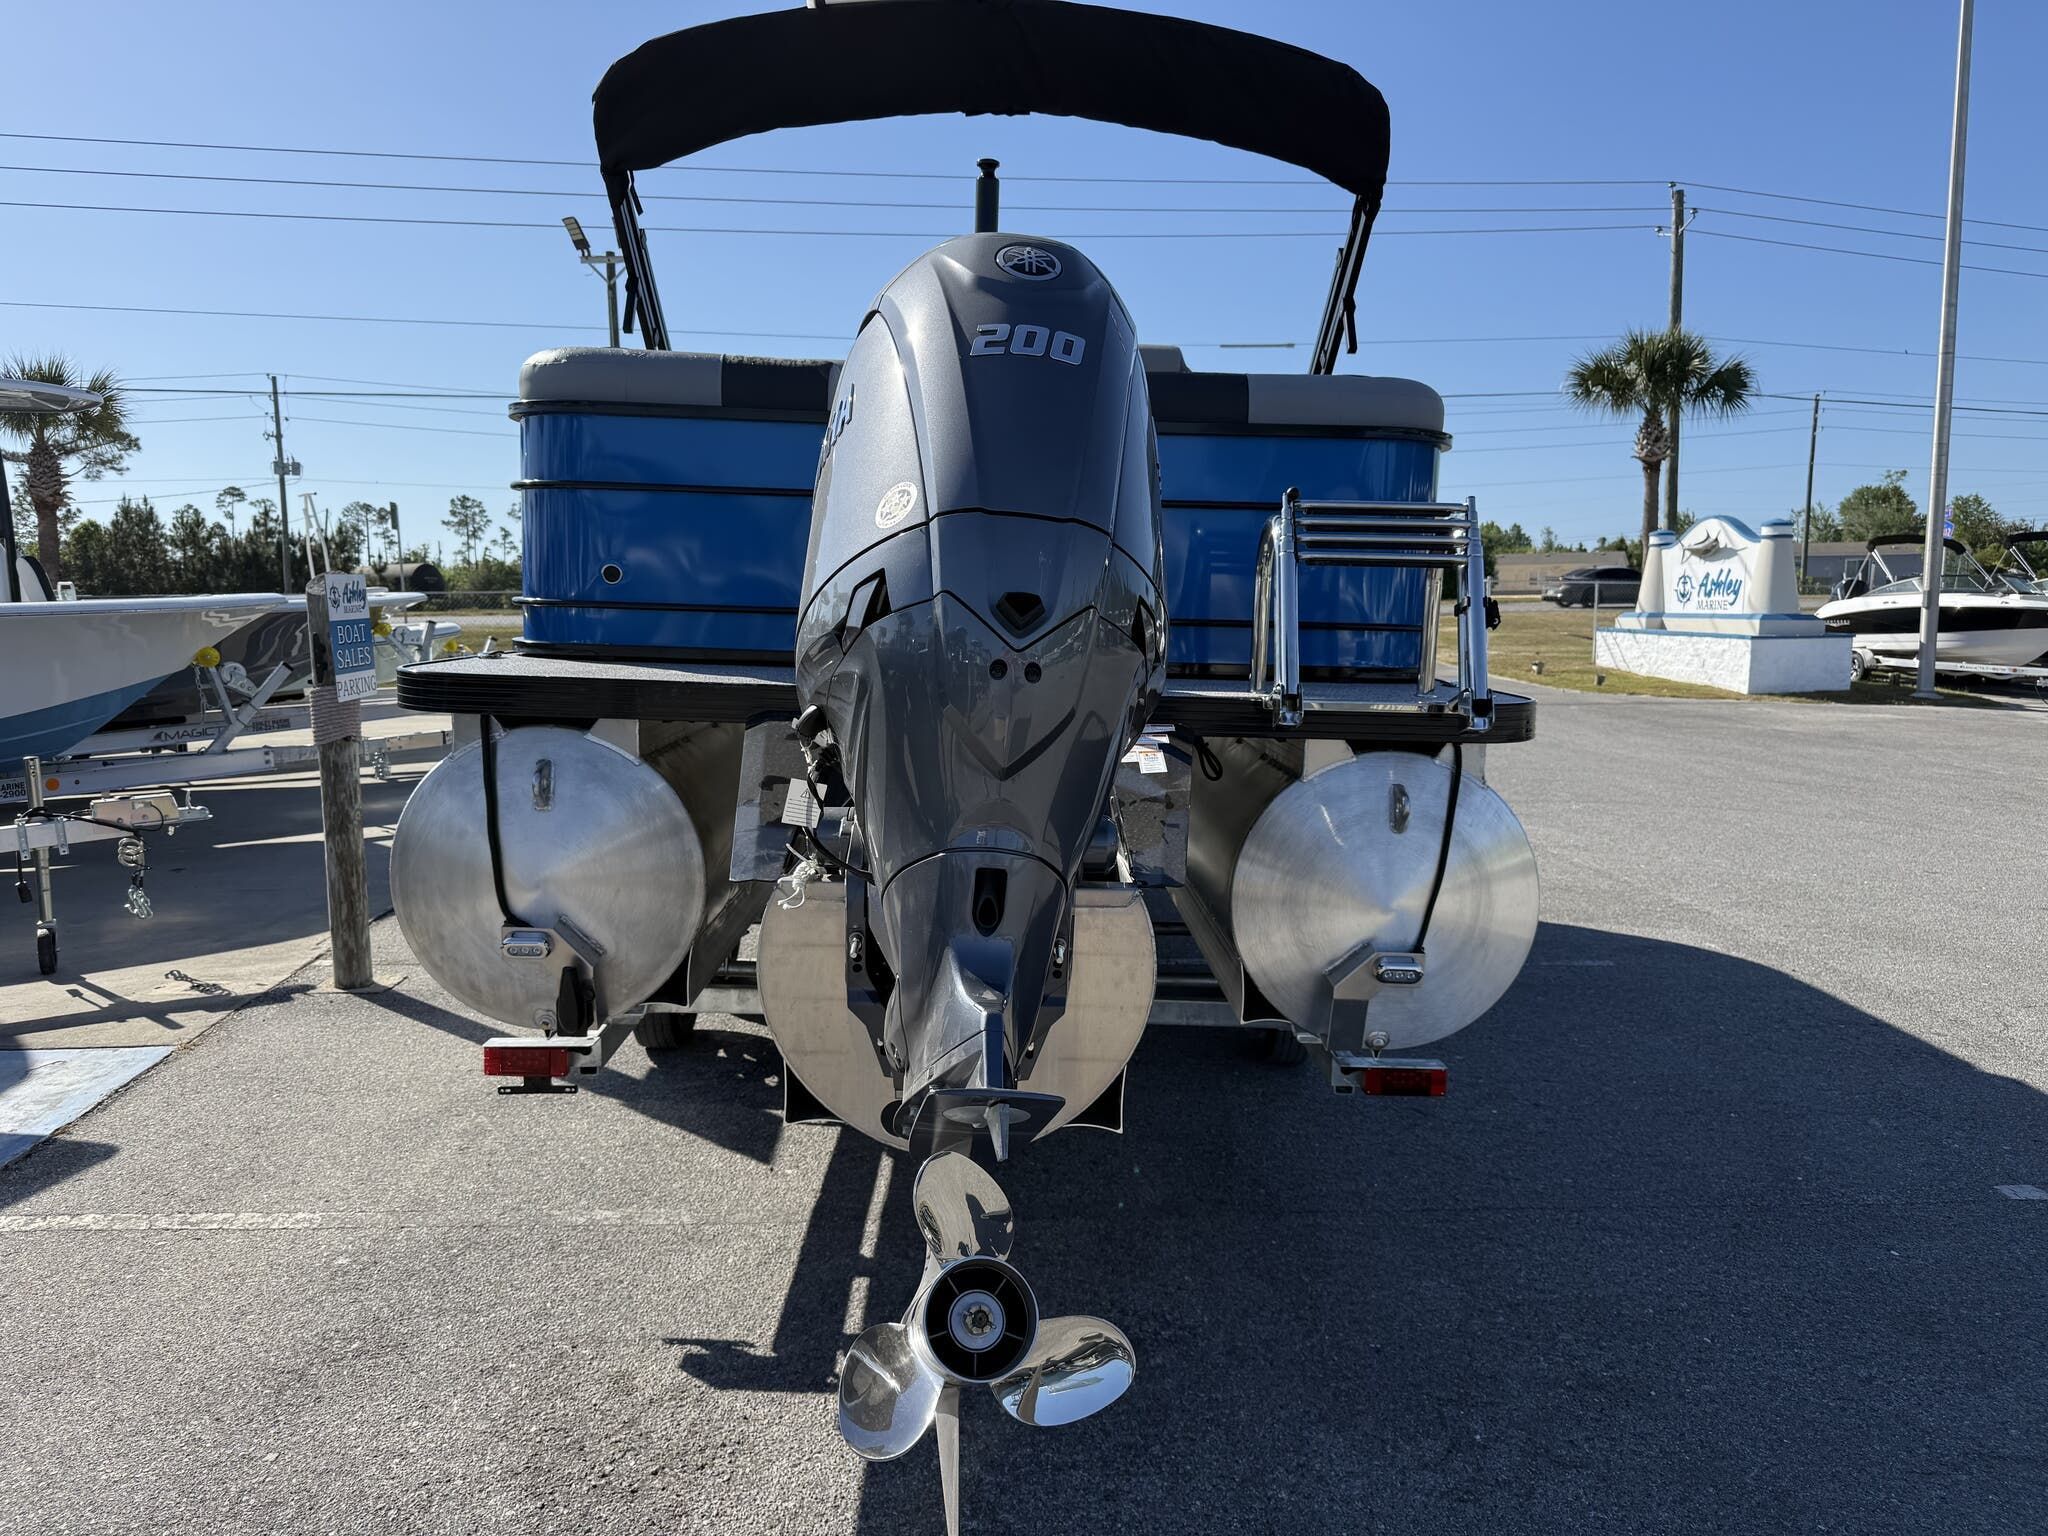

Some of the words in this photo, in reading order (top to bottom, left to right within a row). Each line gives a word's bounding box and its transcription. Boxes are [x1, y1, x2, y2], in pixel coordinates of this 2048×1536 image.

[970, 323, 1086, 365] 200
[342, 581, 366, 609] Ashley
[1697, 568, 1742, 606] Ashley
[1696, 600, 1728, 610] MARINE
[337, 624, 366, 645] BOAT
[336, 646, 371, 669] SALES
[336, 675, 376, 698] PARKING
[1, 781, 25, 791] ARINE
